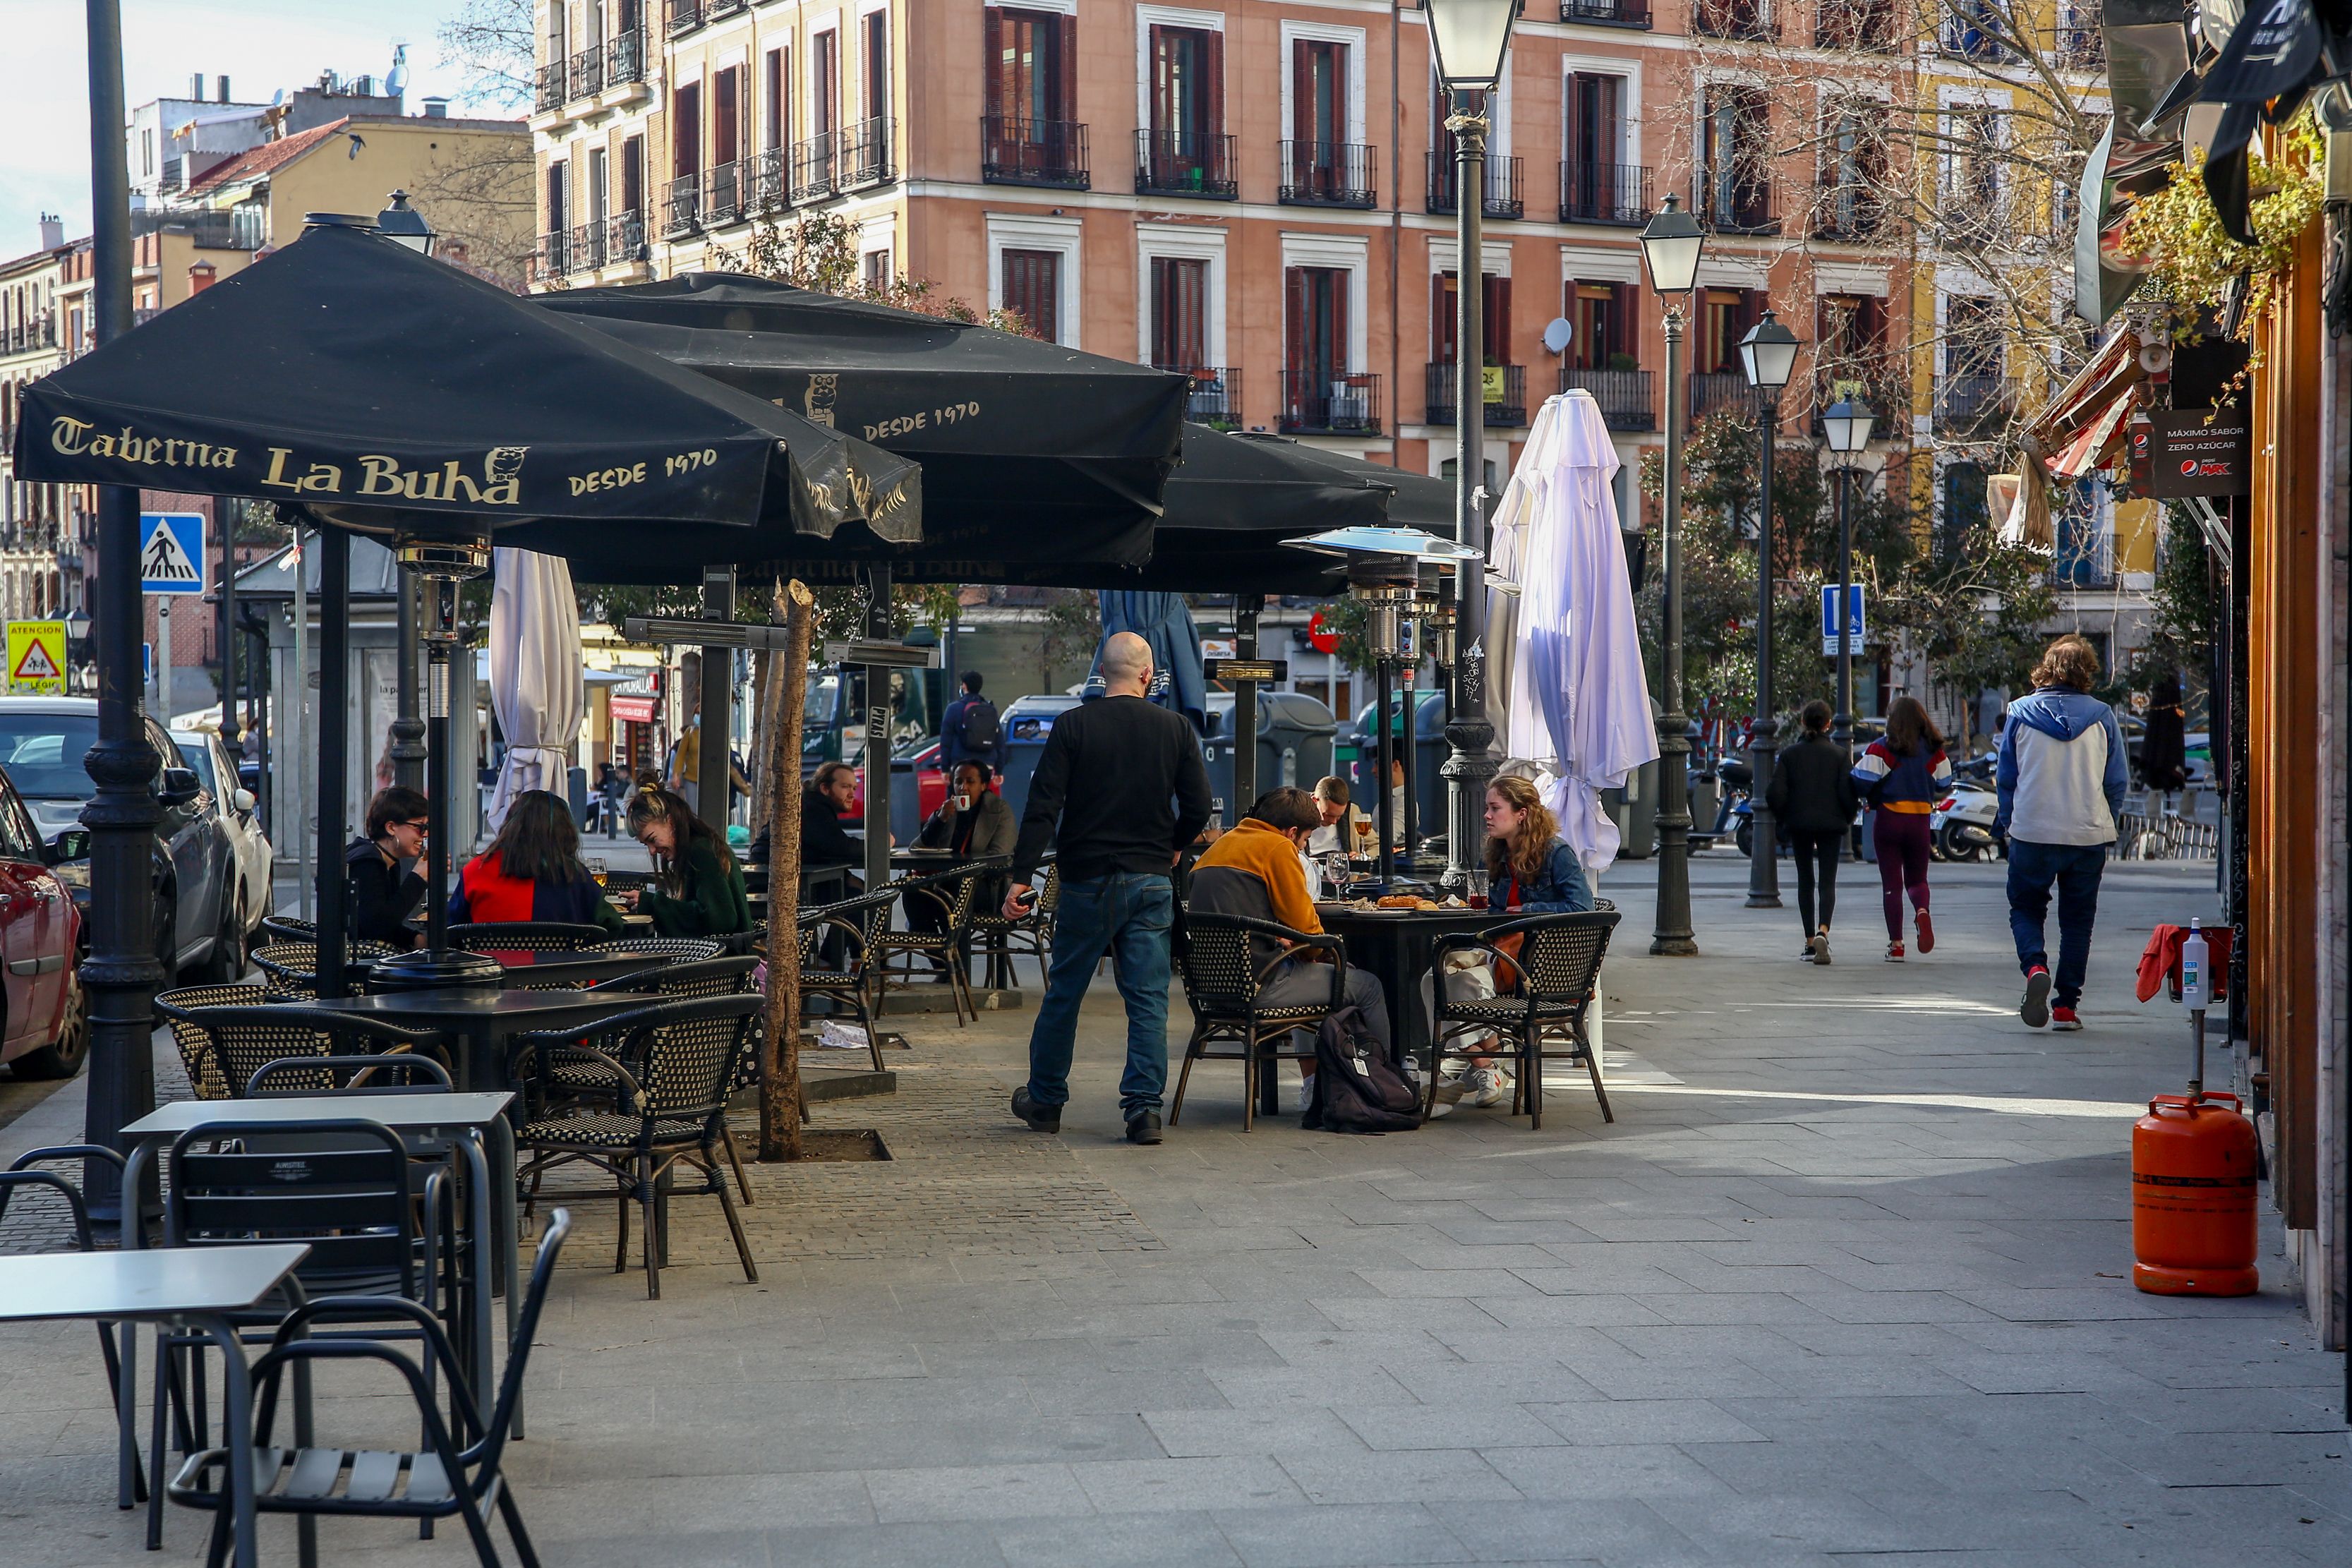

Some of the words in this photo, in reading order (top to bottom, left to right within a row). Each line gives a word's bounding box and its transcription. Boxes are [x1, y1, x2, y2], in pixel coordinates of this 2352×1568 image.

[864, 412, 926, 442] DESDE
[935, 401, 979, 426] 1970
[2167, 429, 2209, 438] MÁXIMO
[2211, 428, 2244, 437] SABOR
[52, 416, 239, 469] Taberna
[260, 447, 342, 493] La
[2197, 441, 2236, 450] AZÚCAR
[568, 462, 646, 496] DESDE
[665, 448, 717, 477] 1970
[2198, 462, 2232, 476] MAX
[11, 626, 61, 634] ATENCION
[870, 707, 886, 737] PYRAS
